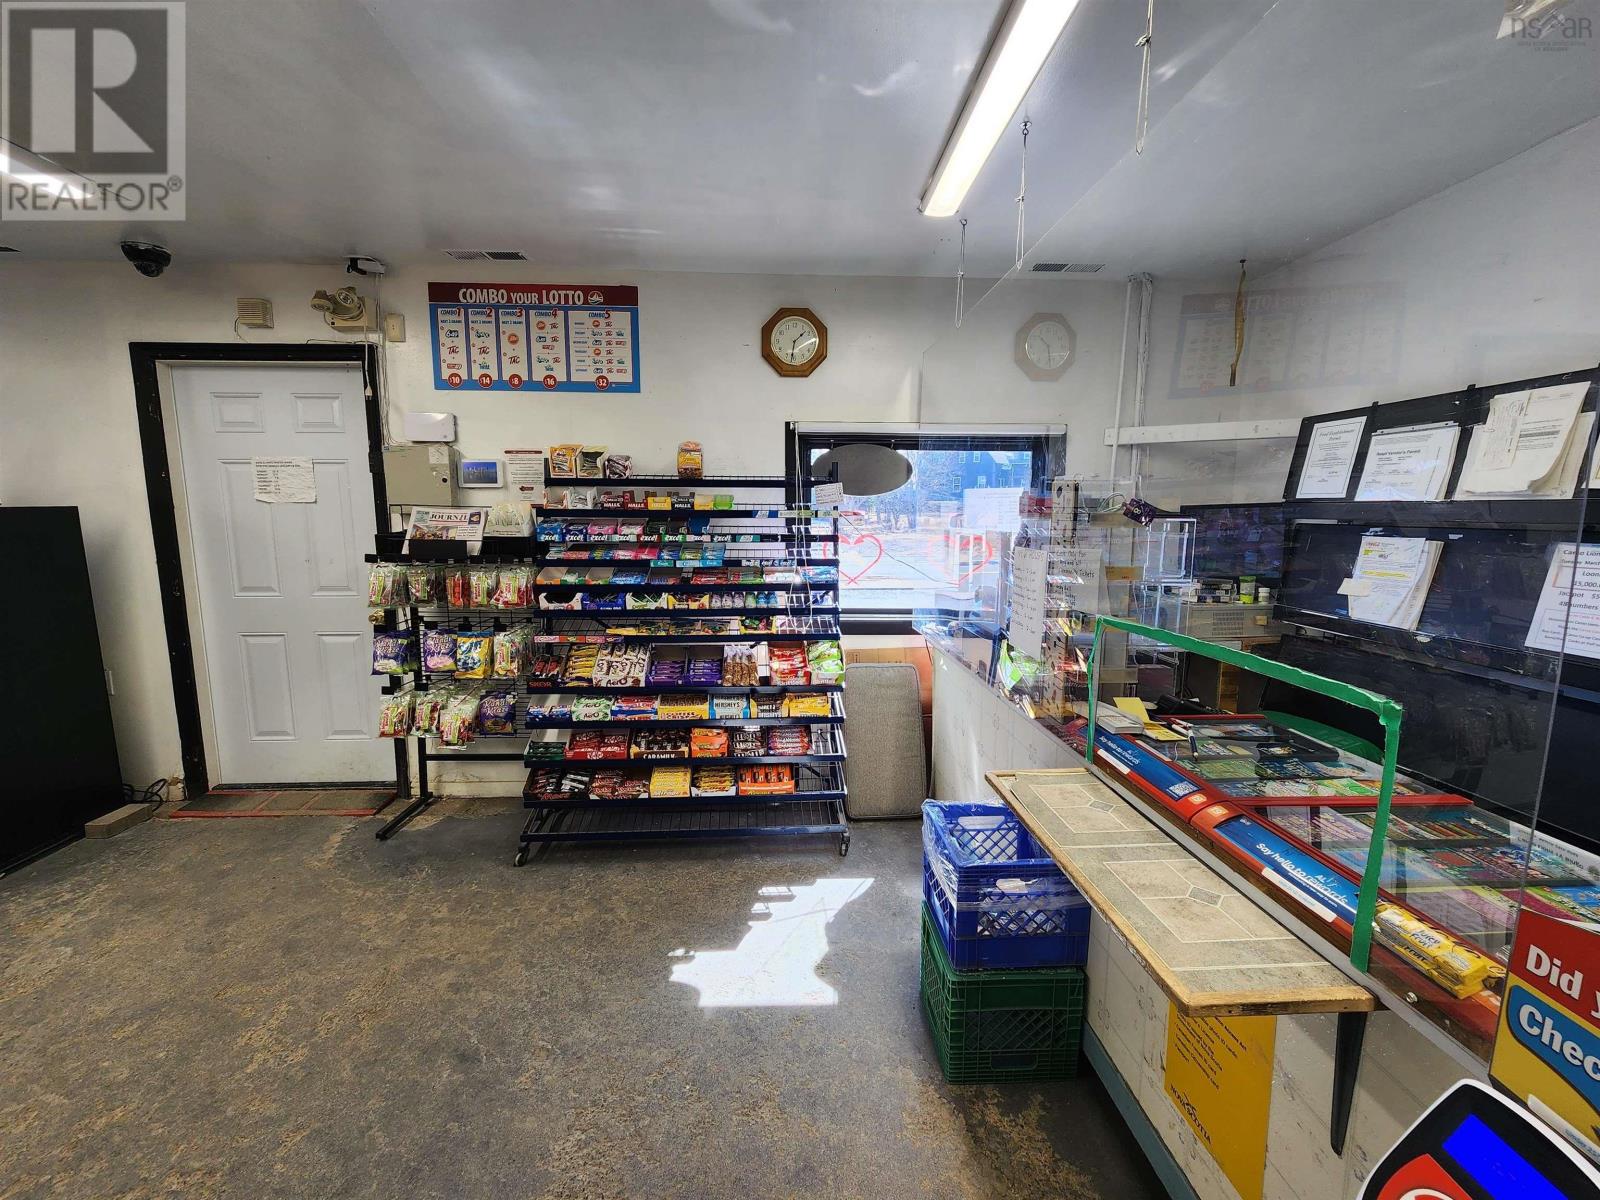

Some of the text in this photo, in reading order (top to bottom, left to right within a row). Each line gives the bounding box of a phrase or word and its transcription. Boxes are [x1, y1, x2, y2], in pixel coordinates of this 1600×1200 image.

[458, 288, 584, 305] COMBO YOUR LOTTO
[1256, 843, 1274, 855] Say
[1271, 851, 1295, 869] hello
[1295, 868, 1306, 878] to
[1304, 875, 1348, 905] rewards
[1525, 944, 1583, 1000] Did
